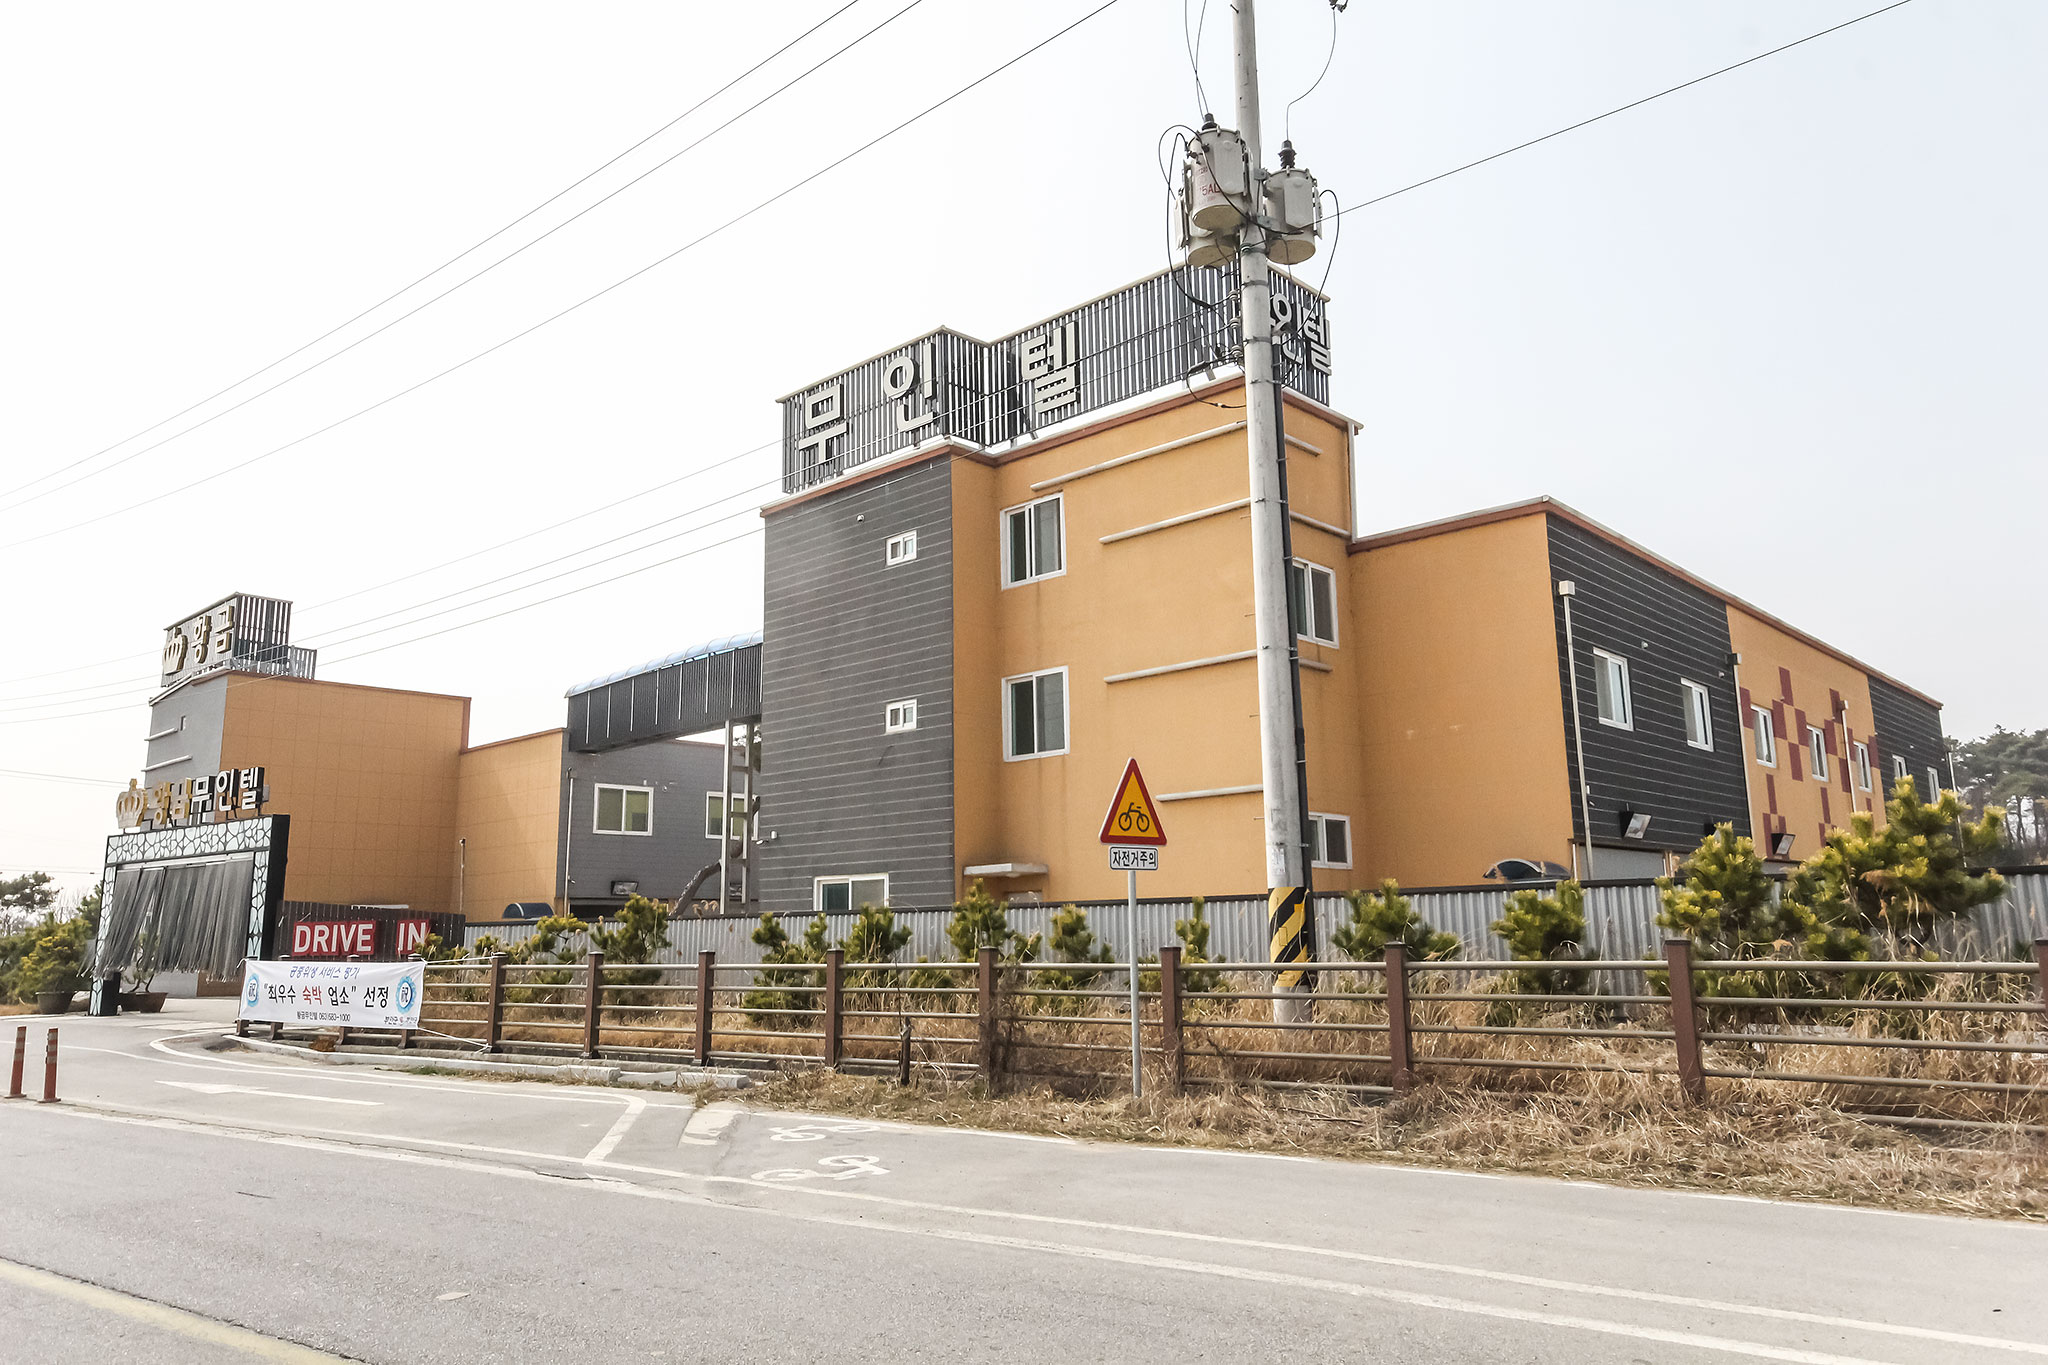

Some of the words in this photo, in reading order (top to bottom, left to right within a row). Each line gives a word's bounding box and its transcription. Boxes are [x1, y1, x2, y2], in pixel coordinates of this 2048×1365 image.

[1271, 292, 1332, 376] 인텔
[191, 605, 234, 663] 황금
[1112, 849, 1157, 867] 자전거주의
[294, 924, 373, 953] DRIVE
[399, 922, 427, 951] IN
[319, 966, 341, 979] 서비스
[302, 985, 323, 1006] 숙박
[363, 986, 389, 1009] 선정
